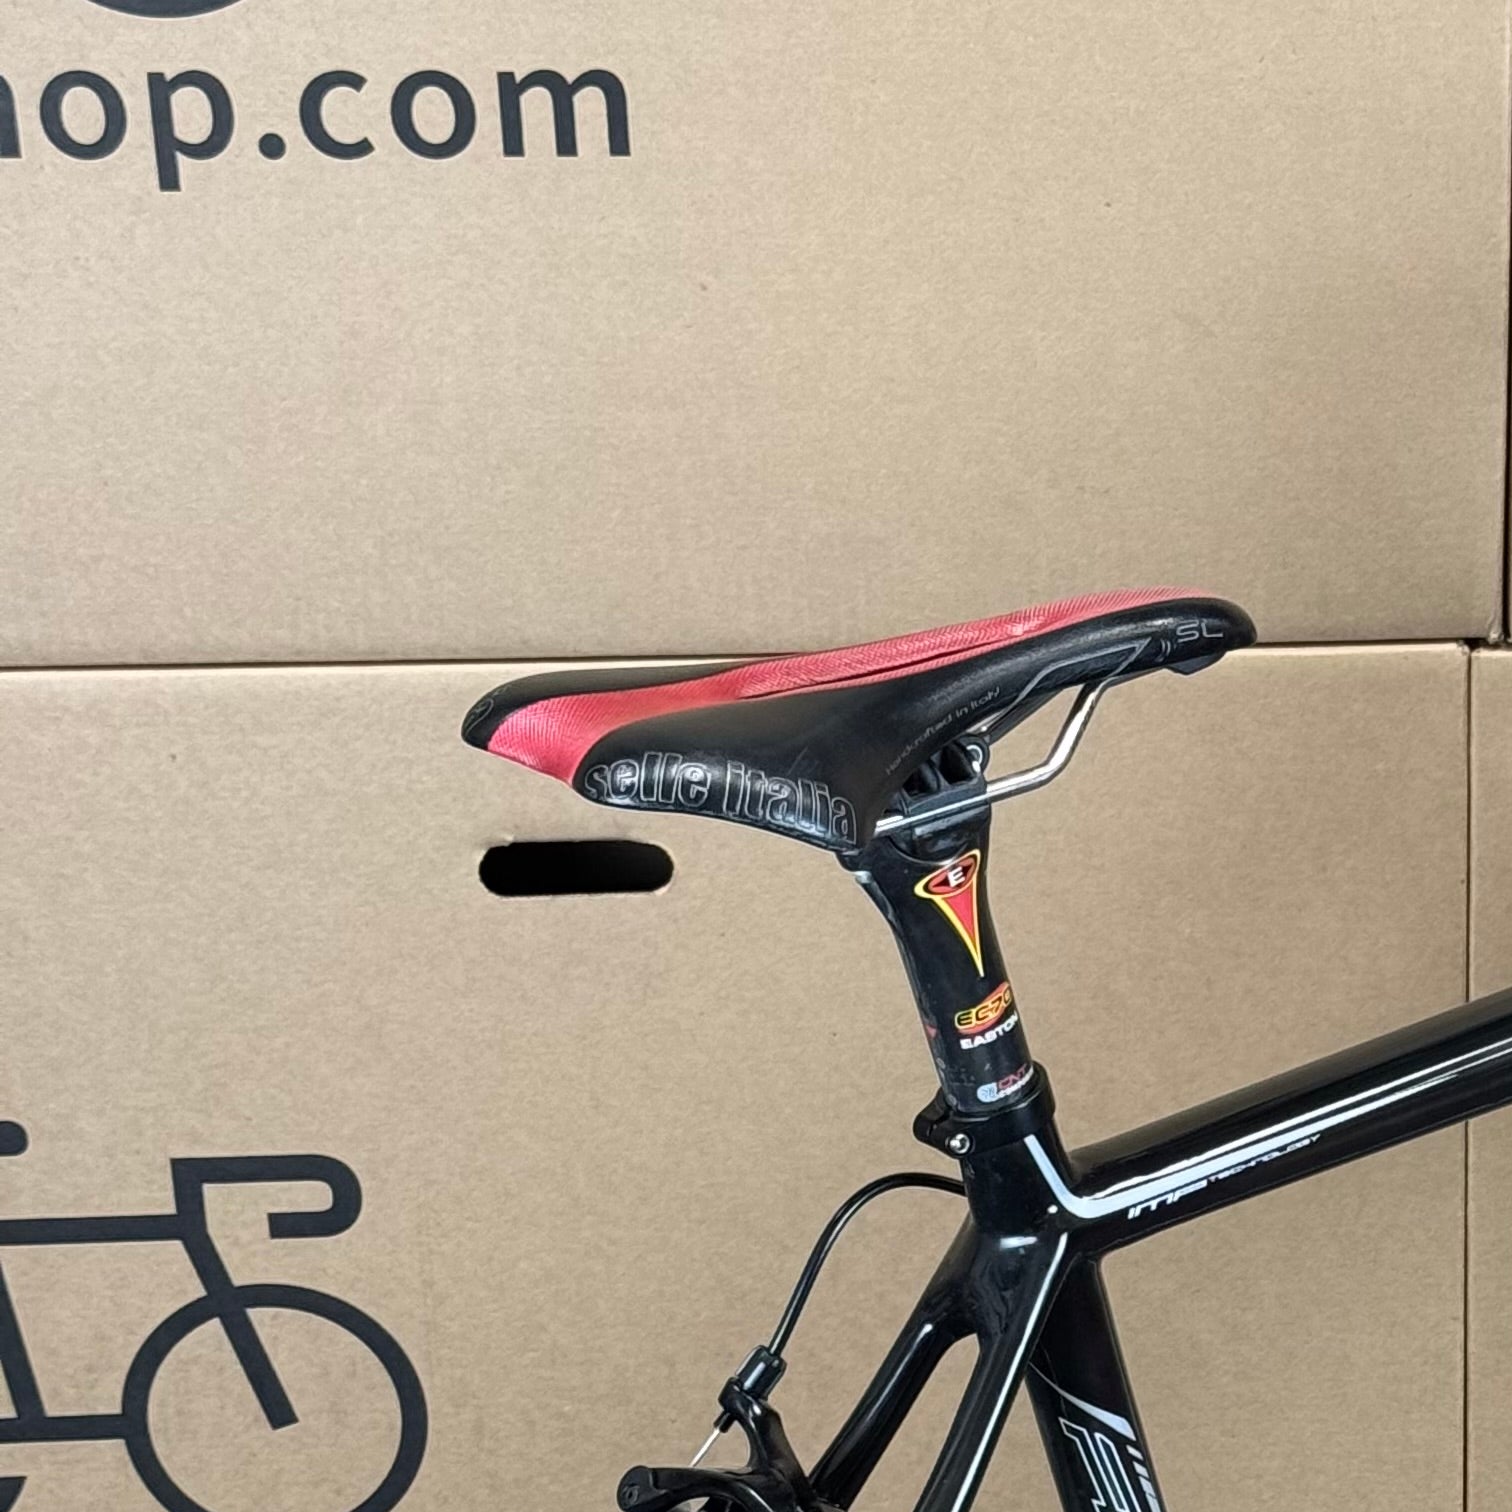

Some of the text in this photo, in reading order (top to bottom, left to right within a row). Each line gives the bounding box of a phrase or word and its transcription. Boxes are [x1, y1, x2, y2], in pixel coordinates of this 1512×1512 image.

[1175, 618, 1224, 643] SL
[971, 687, 1001, 711] Italy
[584, 751, 857, 845] selle italia
